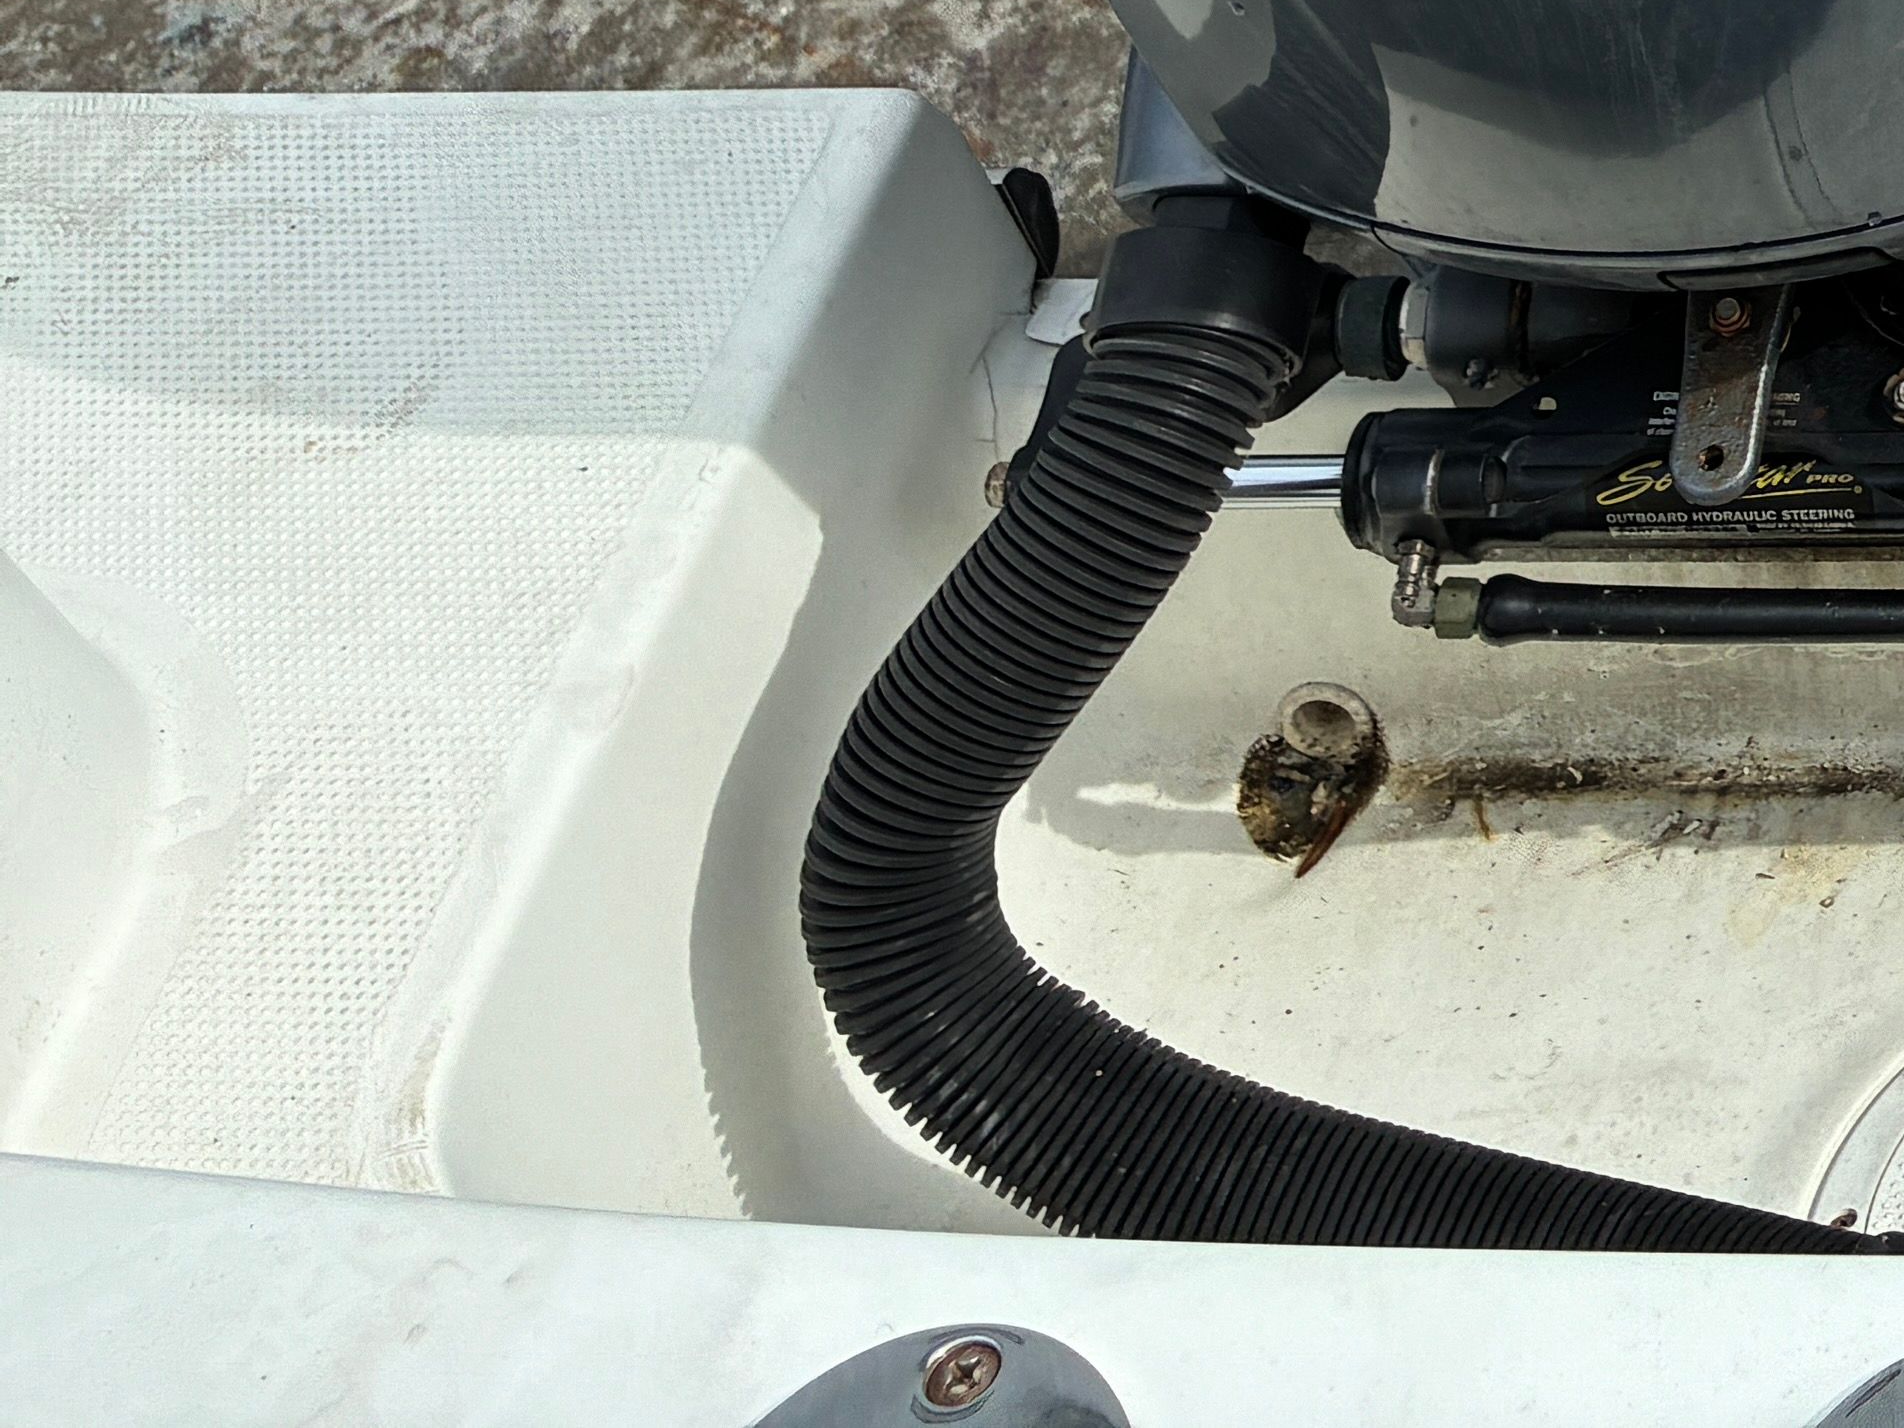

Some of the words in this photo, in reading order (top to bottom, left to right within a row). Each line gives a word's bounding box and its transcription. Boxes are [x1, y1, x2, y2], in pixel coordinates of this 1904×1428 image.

[1806, 473, 1855, 484] PRO
[1606, 511, 1688, 524] OUTBOARD
[1692, 510, 1777, 523] HYDRAULIC
[1781, 508, 1855, 522] STEERING
